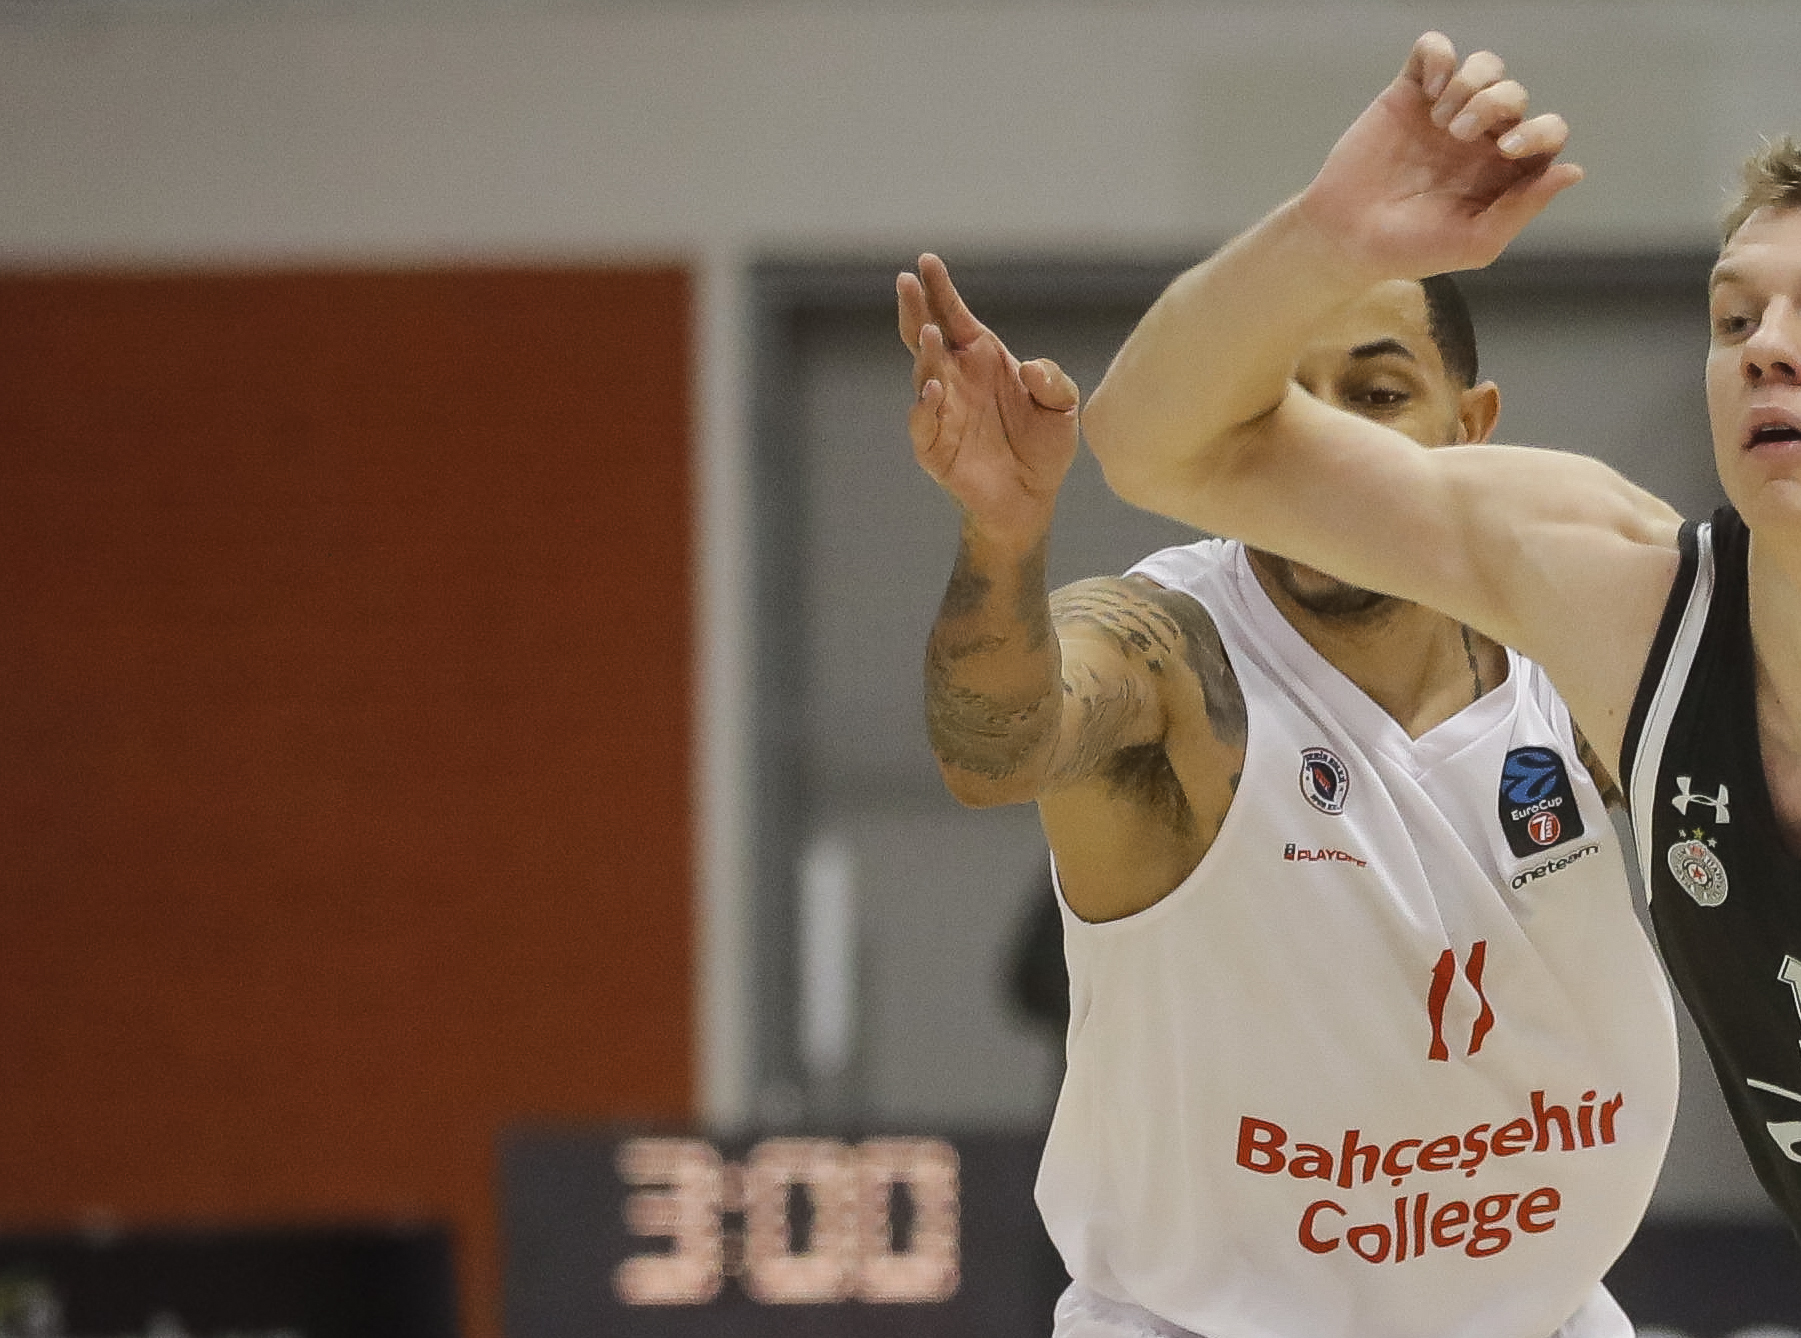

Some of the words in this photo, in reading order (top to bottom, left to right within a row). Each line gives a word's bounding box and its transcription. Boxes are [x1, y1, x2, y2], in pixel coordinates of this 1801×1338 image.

[1510, 797, 1563, 821] EuroCup
[1297, 848, 1367, 868] PLAYO
[1511, 845, 1599, 890] oneteam
[1236, 1091, 1624, 1189] Bahçeşehir
[614, 1135, 961, 1306] 3:00
[1300, 1186, 1562, 1264] College
